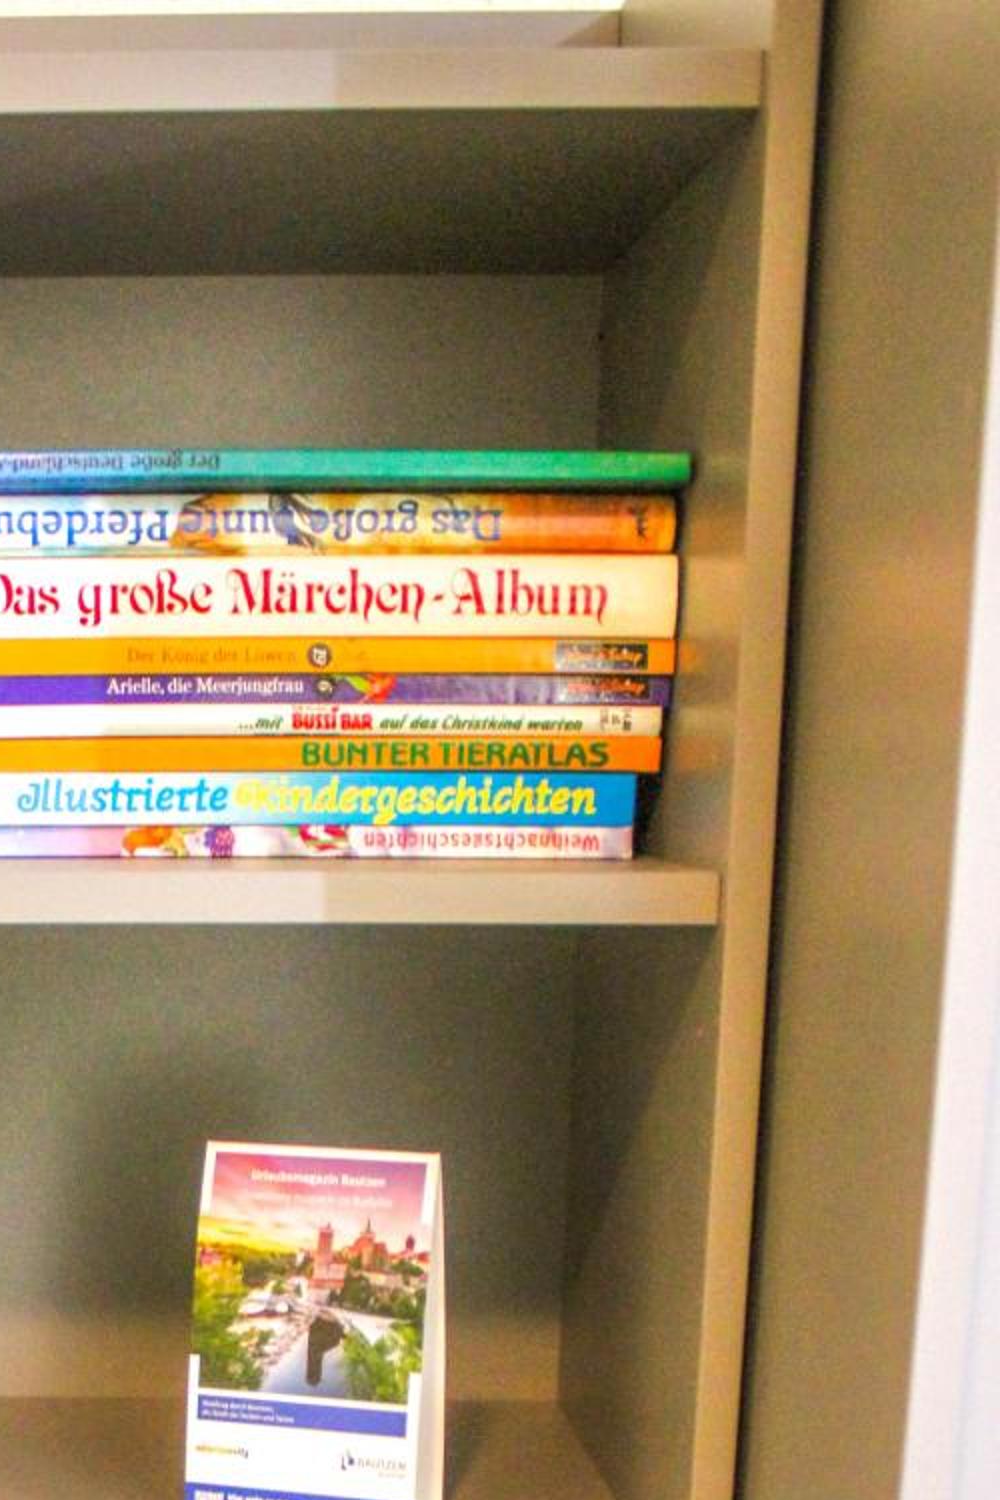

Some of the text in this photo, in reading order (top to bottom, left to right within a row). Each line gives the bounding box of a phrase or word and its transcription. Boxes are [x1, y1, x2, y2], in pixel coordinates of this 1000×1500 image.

[309, 498, 419, 542] große
[431, 507, 504, 543] Das
[77, 568, 214, 628] große
[230, 566, 609, 627] Märchen-Album
[106, 677, 305, 698] Arielle, die Meerjungfrau
[378, 713, 406, 731] auf
[410, 714, 439, 731] das
[440, 713, 526, 732] Christkind
[526, 716, 584, 733] warten
[301, 740, 610, 768] BUNTER TIERATLAS
[16, 774, 598, 827] Illustrierte Kindergeschichten
[363, 830, 601, 852] Weihnachtsgeschichten
